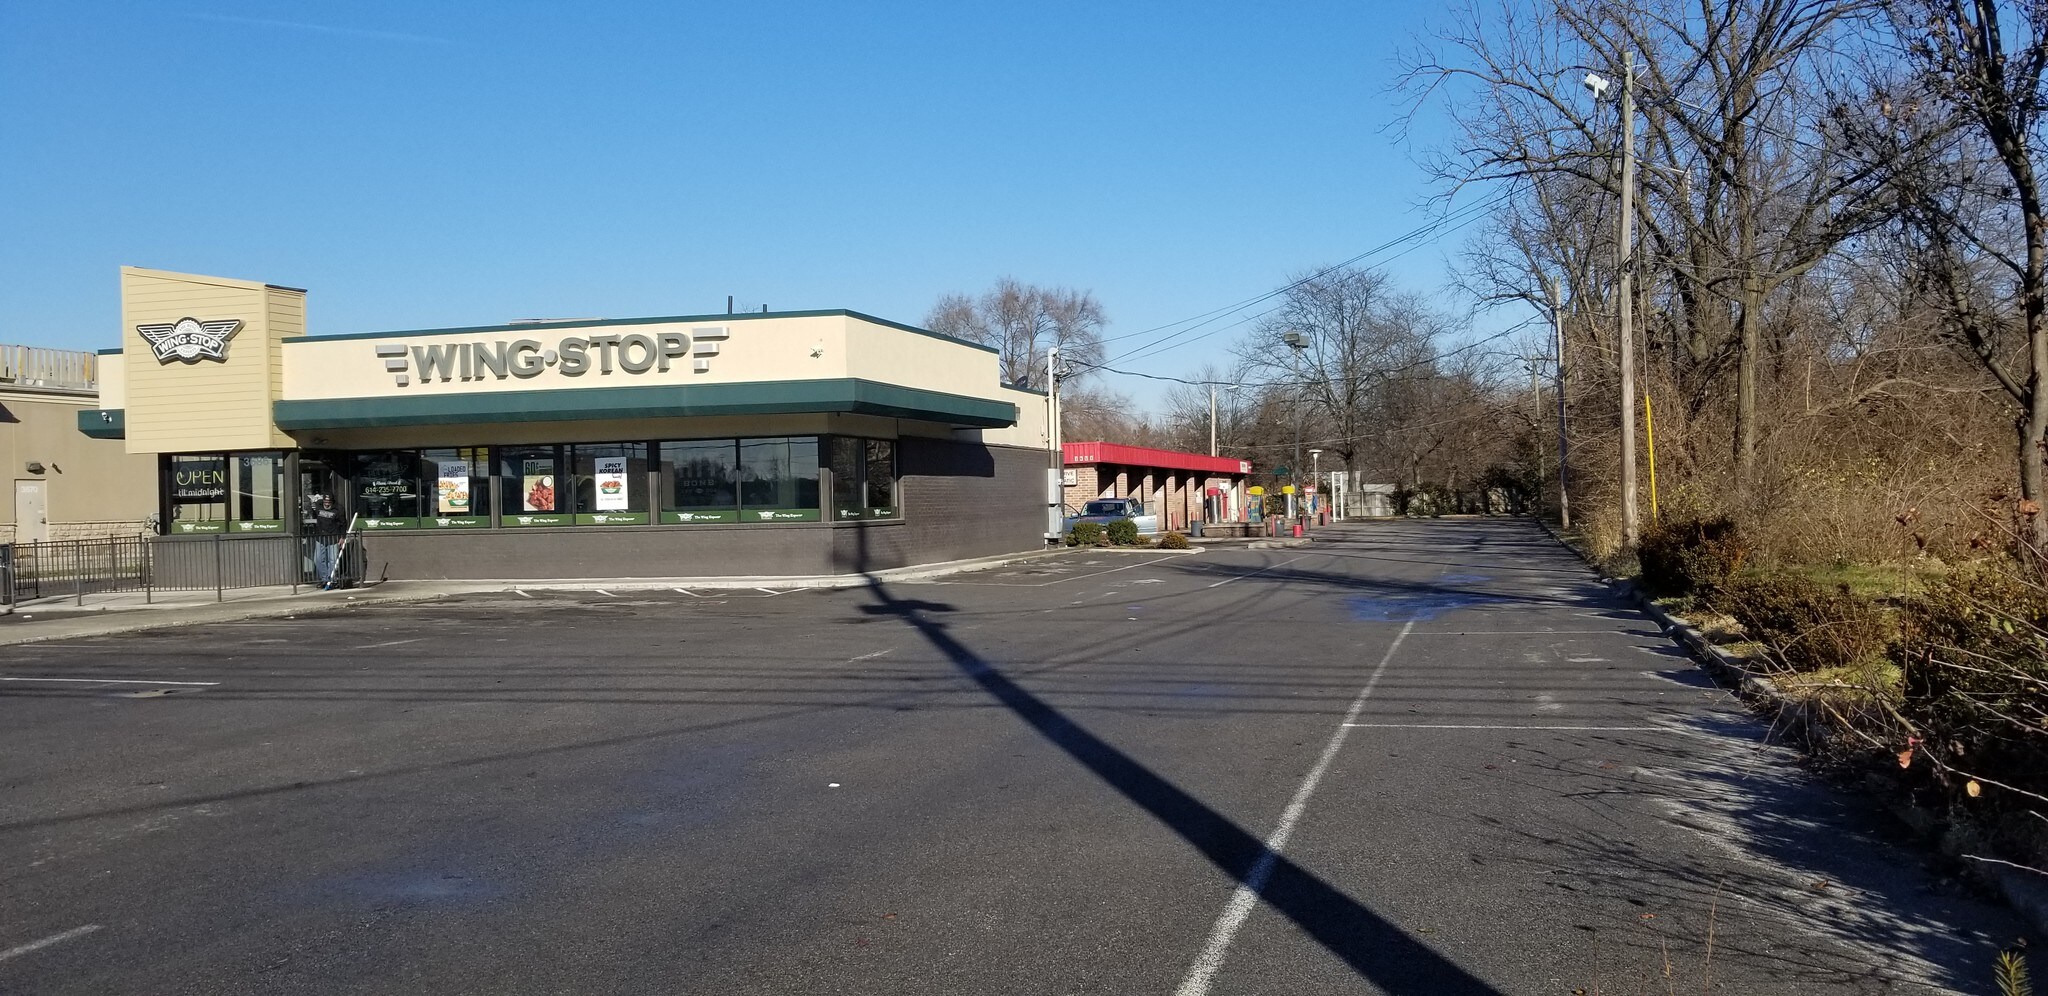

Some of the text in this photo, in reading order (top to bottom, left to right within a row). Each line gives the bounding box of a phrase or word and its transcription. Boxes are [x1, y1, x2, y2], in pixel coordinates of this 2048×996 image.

[176, 469, 224, 486] OPEN
[188, 487, 224, 498] midnight
[365, 486, 407, 494] 614-235-7700
